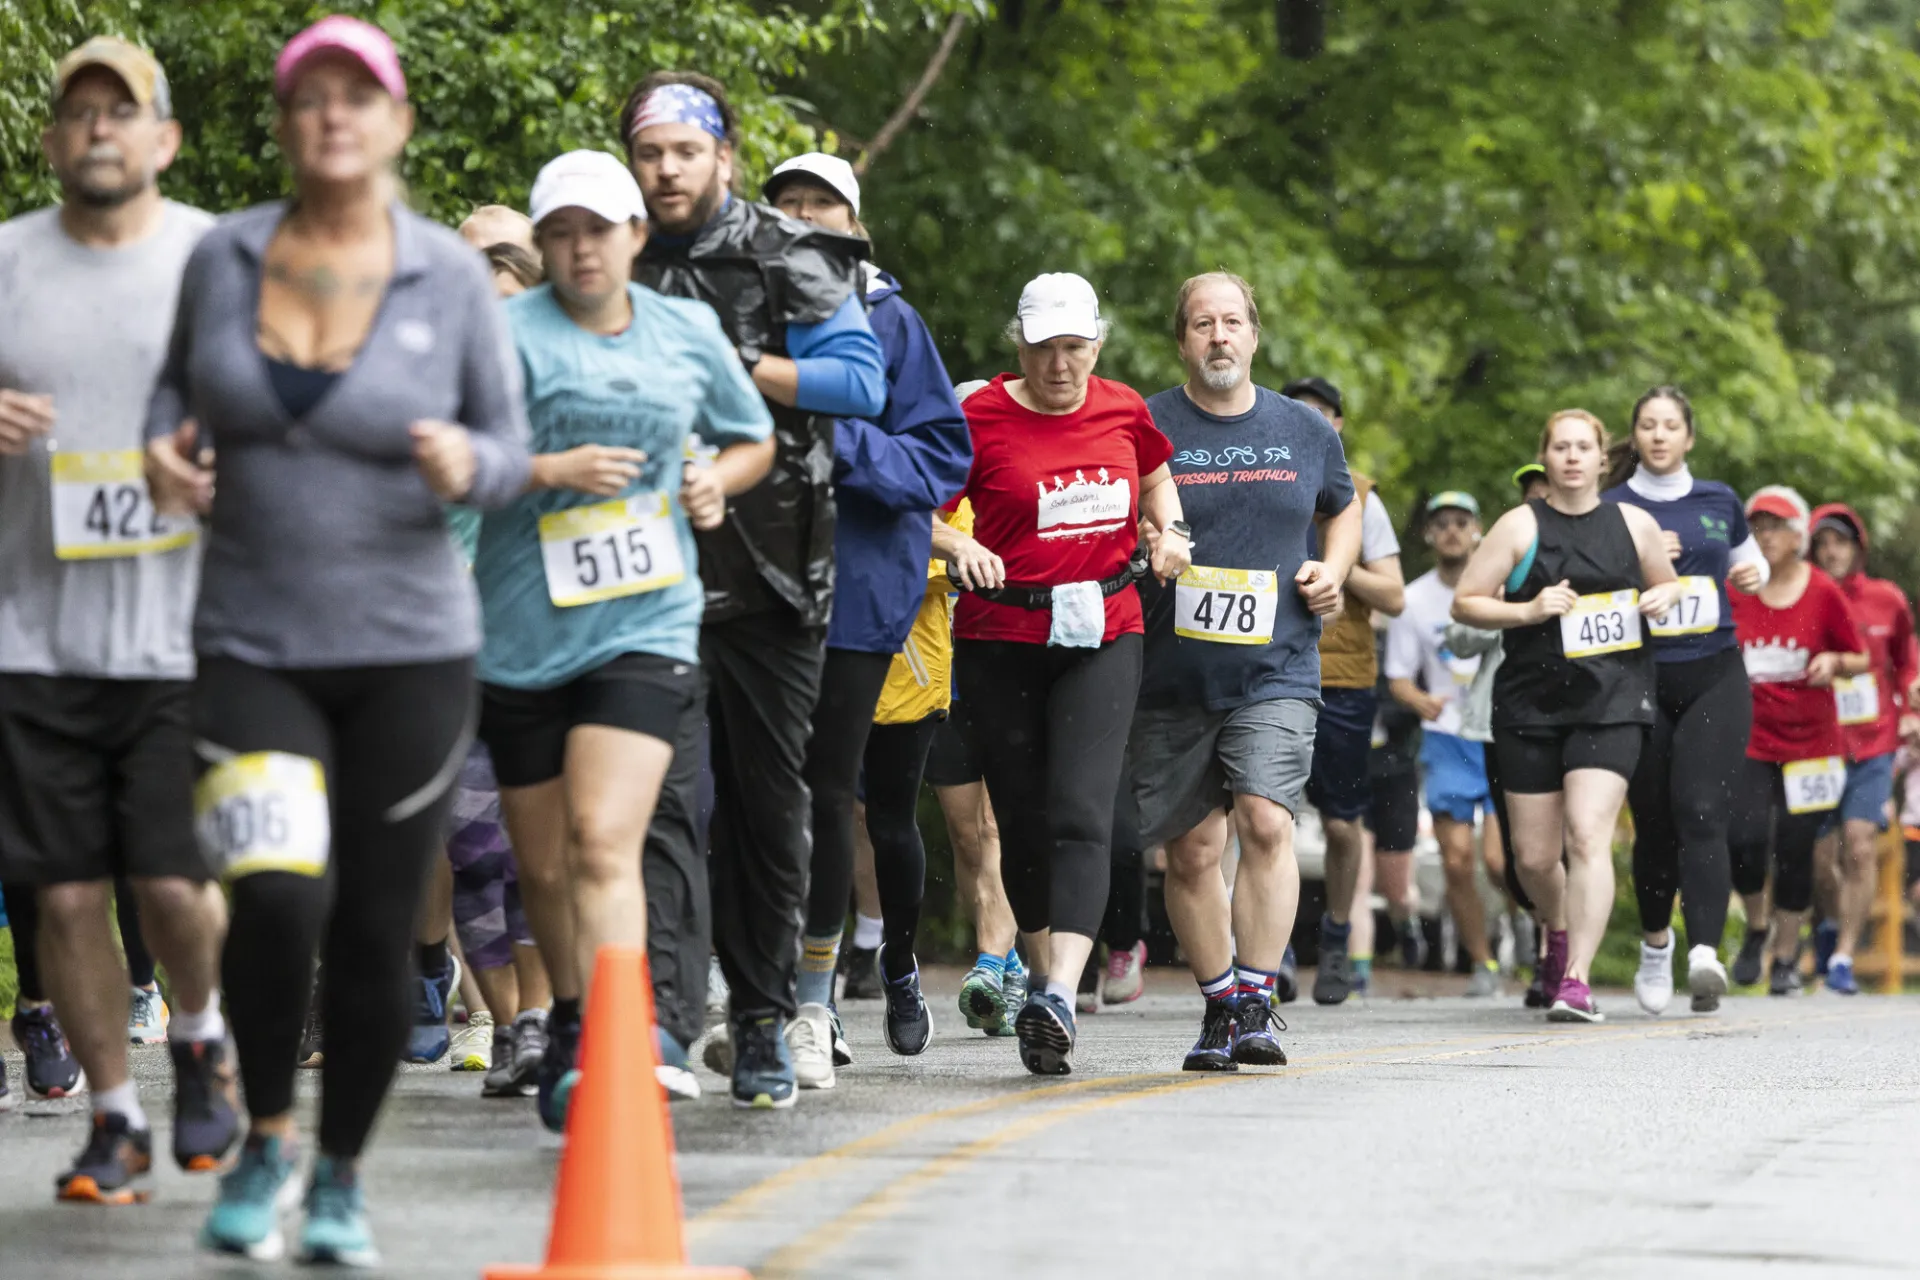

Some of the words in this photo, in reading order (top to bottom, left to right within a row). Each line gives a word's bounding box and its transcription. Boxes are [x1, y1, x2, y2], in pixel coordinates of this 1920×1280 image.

[1232, 469, 1297, 483] TRIATHLON
[1049, 498, 1068, 510] Sole
[1070, 492, 1100, 505] Sisters
[573, 528, 652, 587] 515
[1193, 591, 1257, 633] 478
[1579, 611, 1625, 646] 463
